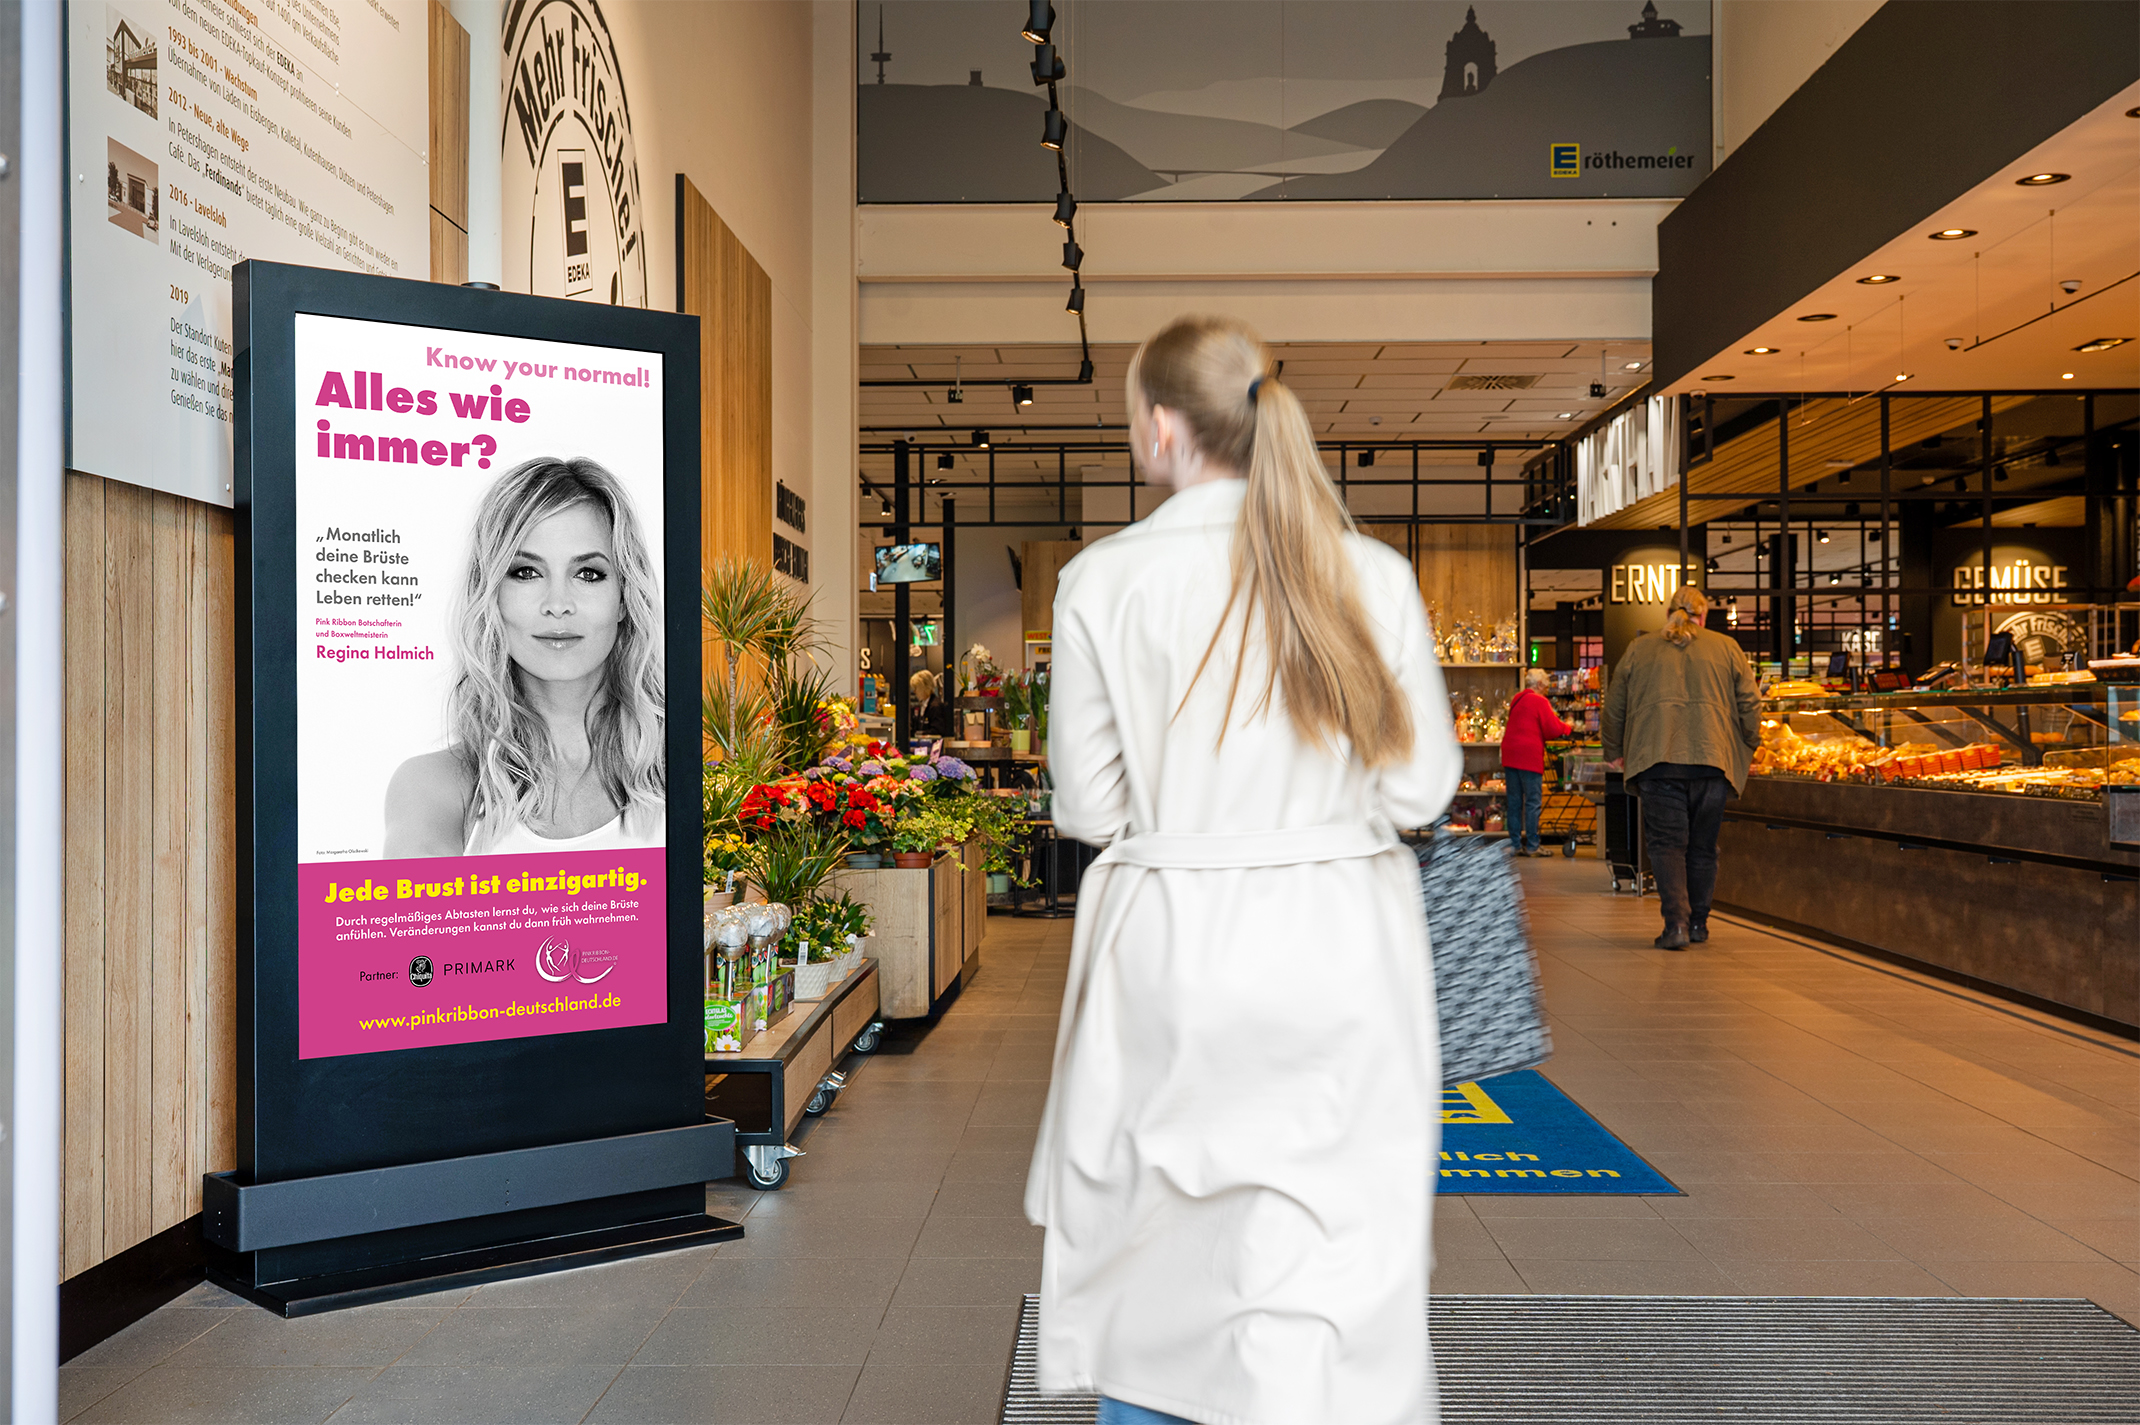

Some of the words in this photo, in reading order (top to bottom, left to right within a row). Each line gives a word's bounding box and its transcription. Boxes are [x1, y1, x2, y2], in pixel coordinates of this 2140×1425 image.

[182, 3, 198, 25] dem
[199, 15, 221, 41] neuen
[167, 25, 187, 51] 1993
[188, 37, 199, 60] bis
[200, 48, 218, 74] 2001
[223, 65, 258, 102] Wachstum
[265, 41, 276, 62] der
[276, 50, 296, 77] EDEKA
[167, 43, 208, 87] Übernahme
[208, 77, 222, 97] von
[222, 84, 242, 111] Läden
[242, 98, 249, 116] in
[168, 86, 187, 112] 2012
[193, 103, 215, 132] Neue,
[215, 118, 230, 139] alte
[230, 127, 250, 153] Wege
[514, 15, 566, 171] Mehr
[571, 11, 637, 261] Frische!
[168, 116, 176, 135] In
[177, 122, 219, 162] Petershagen
[219, 152, 246, 178] entsteht
[246, 165, 258, 185] der
[258, 176, 274, 195] erste
[1584, 148, 1695, 169] röthemeier
[169, 183, 189, 207] 2016
[194, 197, 227, 229] Lavelsloh
[187, 152, 201, 173] Das
[245, 185, 264, 211] bietet
[264, 198, 284, 223] täglich
[284, 212, 298, 231] eine
[169, 214, 177, 232] In
[178, 218, 210, 249] Lavelsloh
[210, 239, 238, 265] entsteht
[169, 238, 182, 258] Mit
[182, 244, 195, 264] der
[195, 251, 232, 281] Verlagerun
[567, 262, 591, 283] EDEKA
[169, 284, 189, 305] 2019
[170, 316, 184, 336] Der
[184, 322, 213, 348] Standort
[170, 338, 185, 360] hier
[185, 345, 199, 366] das
[199, 355, 216, 373] erste
[427, 347, 497, 372] Know
[503, 361, 558, 380] your
[565, 367, 649, 388] normal!
[170, 367, 180, 382] zu
[180, 370, 206, 392] wählen
[207, 380, 220, 397] und
[315, 371, 437, 415] Alles
[449, 384, 530, 423] wie
[170, 388, 204, 414] Genießen
[204, 400, 216, 418] Sie
[215, 403, 228, 422] das
[317, 419, 497, 469] immer?
[316, 547, 358, 562] deine
[364, 550, 409, 564] Brüste
[316, 568, 376, 584] checken
[382, 571, 418, 585] kann
[1611, 564, 1697, 602] ERNT
[1954, 559, 2068, 604] GEMÜSE
[317, 590, 361, 604] Leben
[367, 594, 422, 606] retten!“
[332, 618, 356, 626] Ribbon
[358, 619, 402, 627] Botschafterin
[317, 645, 369, 662] Regina
[375, 645, 433, 660] Halmich
[325, 879, 388, 903] Jede
[397, 877, 464, 899] Brust
[470, 874, 500, 894] ist
[507, 867, 647, 895] einzigartig.
[336, 915, 367, 926] Durch
[371, 911, 442, 924] regelmäßiges
[445, 909, 489, 919] Abtasten
[493, 907, 519, 916] lernst
[522, 905, 537, 915] du,
[541, 904, 558, 913] wie
[562, 902, 579, 912] sich
[582, 901, 607, 911] deine
[611, 900, 639, 909] Brüste
[336, 929, 386, 941] anfühlen.
[389, 924, 471, 938] Veränderungen
[474, 922, 506, 931] kannst
[509, 919, 521, 929] du
[525, 918, 549, 928] dann
[552, 916, 571, 926] früh
[574, 913, 638, 924] wahrnehmen.
[360, 971, 398, 981] Partner:
[444, 959, 514, 975] PRIMARK
[359, 992, 622, 1030] www.pinkribbon-deutschland.de
